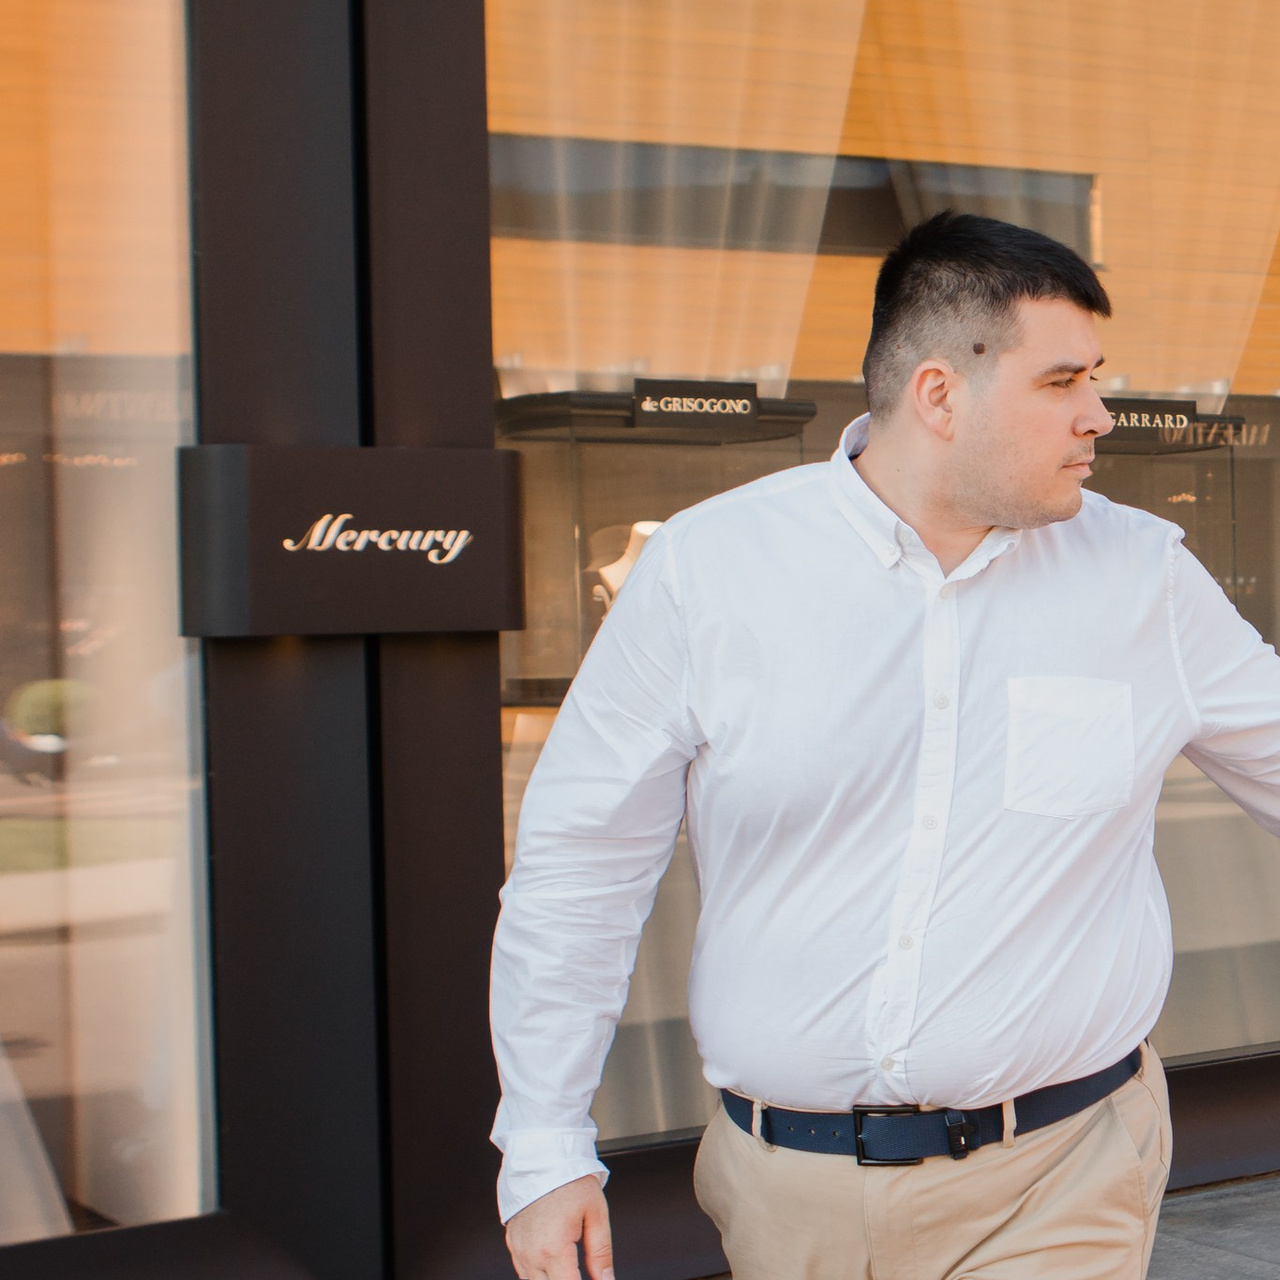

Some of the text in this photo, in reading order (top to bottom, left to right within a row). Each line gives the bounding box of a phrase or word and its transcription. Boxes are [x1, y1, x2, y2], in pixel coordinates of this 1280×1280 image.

[641, 396, 751, 414] de GRISOGONO
[282, 513, 474, 564] Mercury
